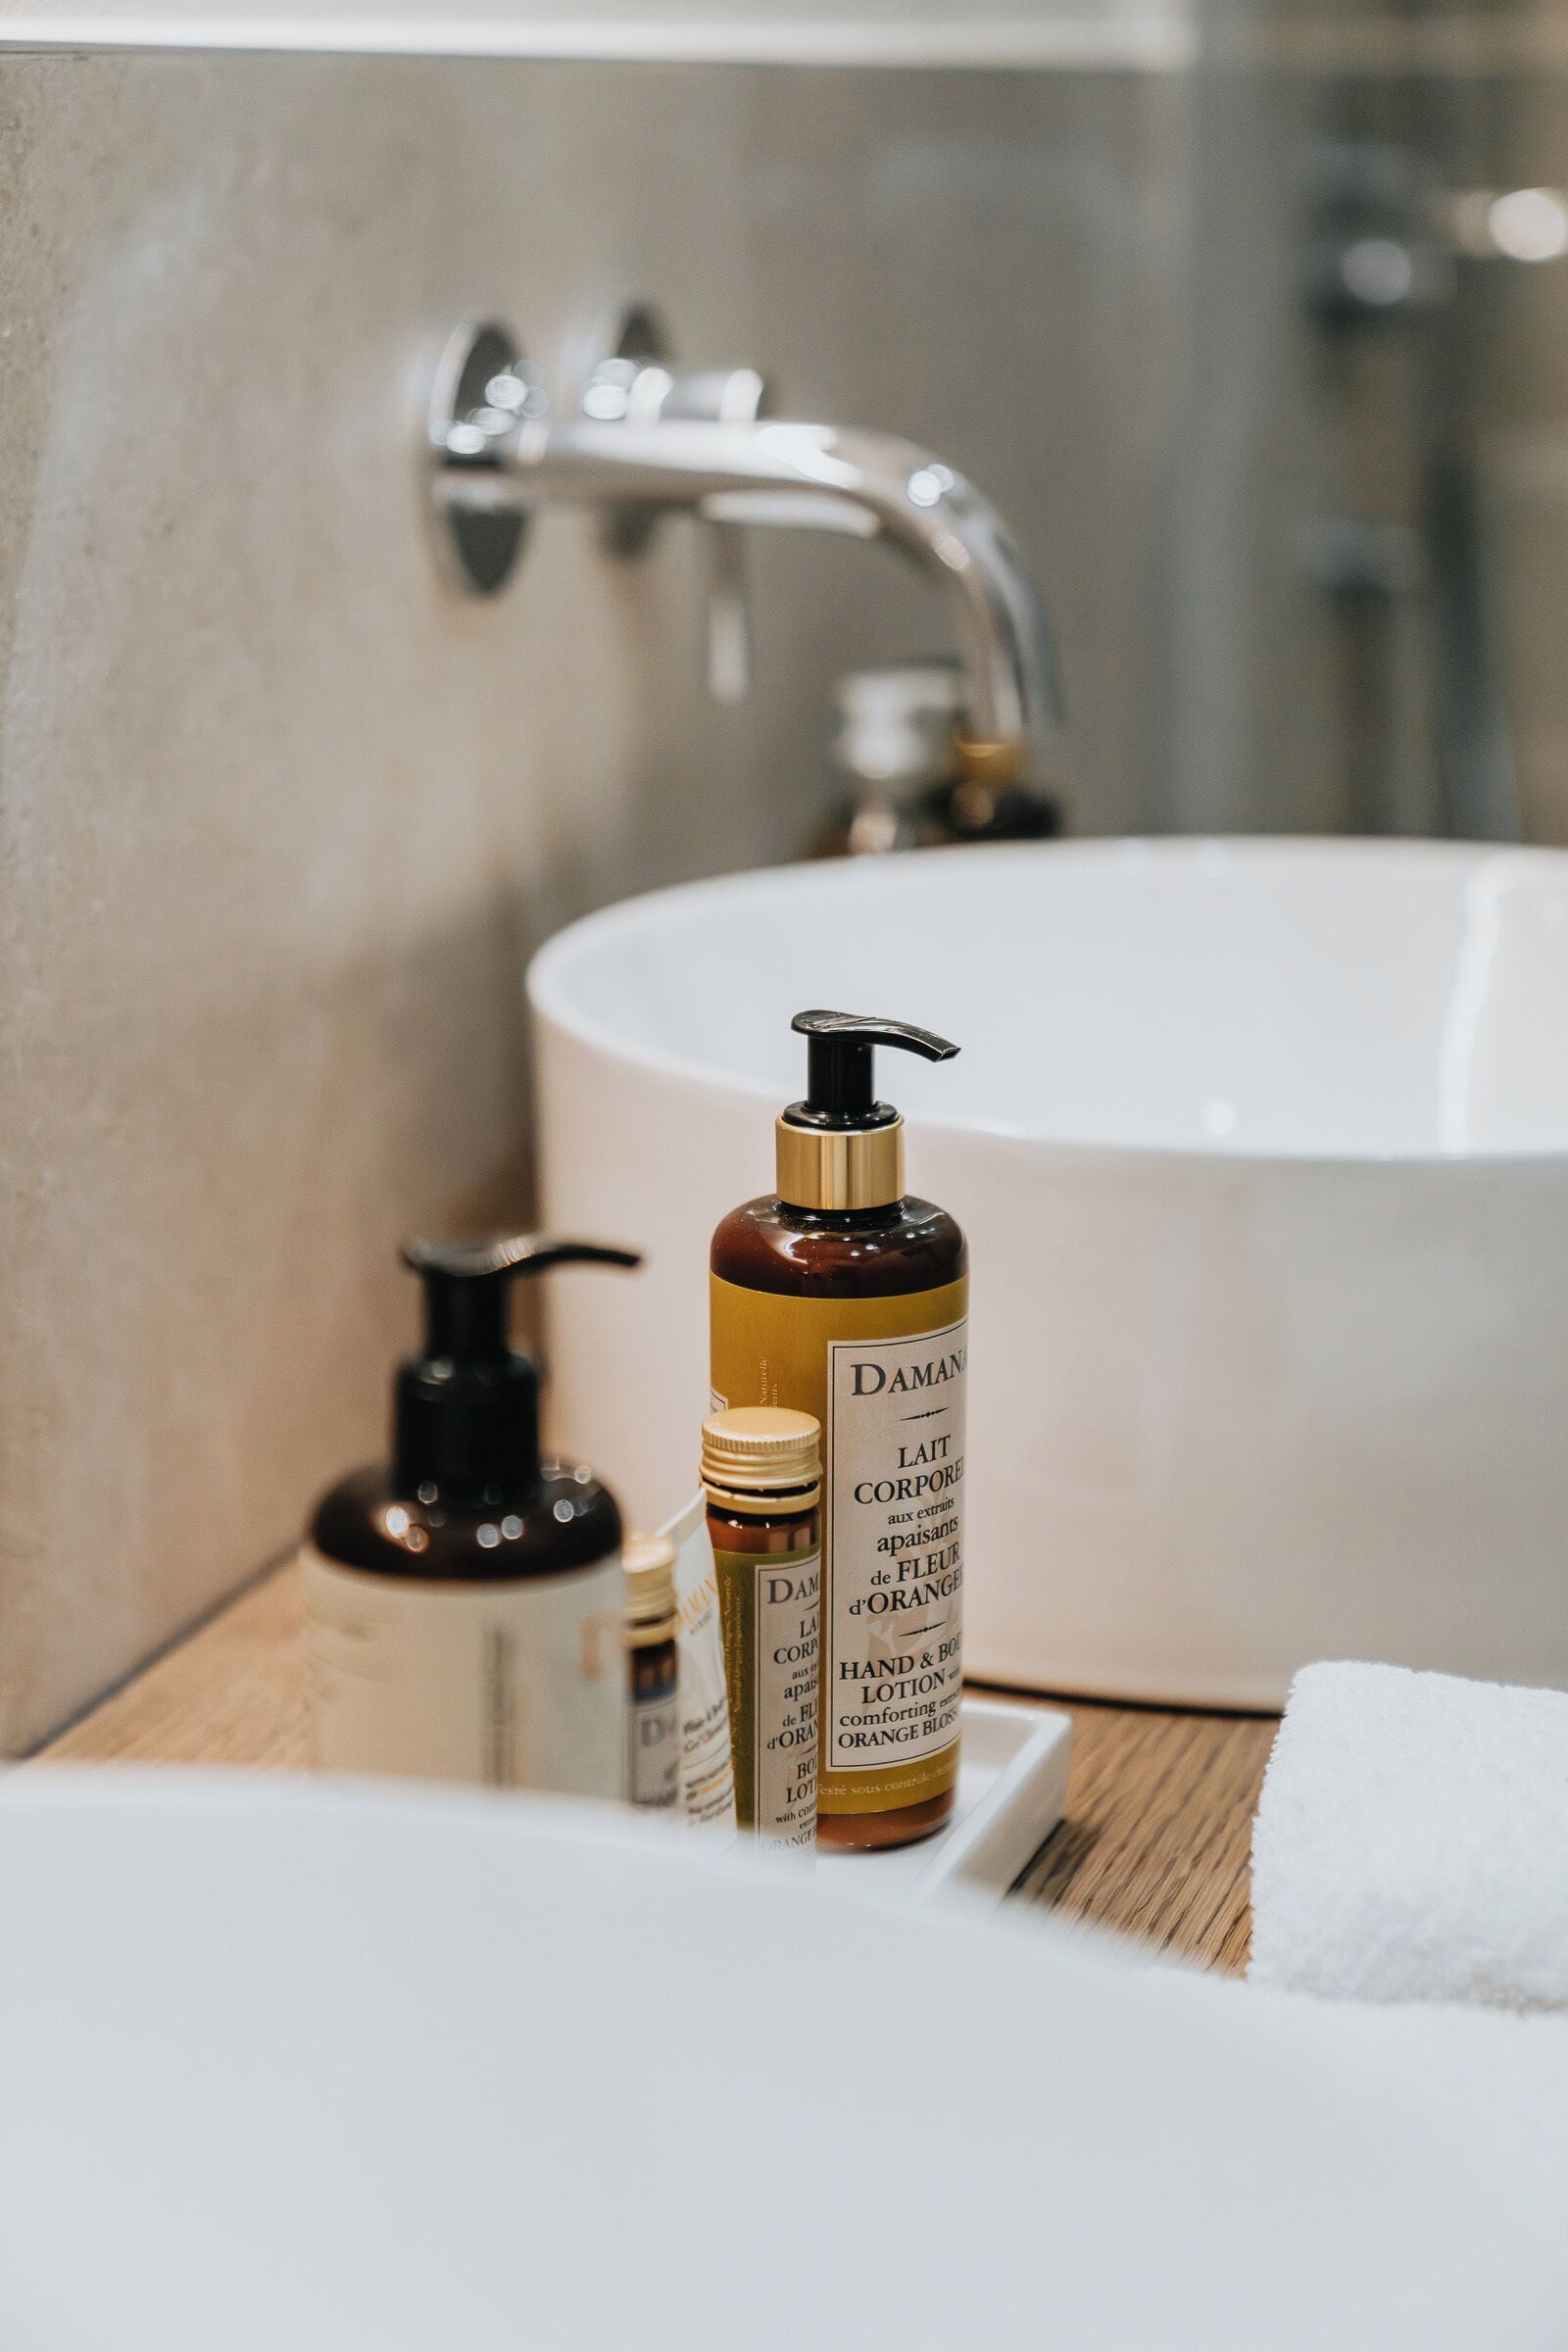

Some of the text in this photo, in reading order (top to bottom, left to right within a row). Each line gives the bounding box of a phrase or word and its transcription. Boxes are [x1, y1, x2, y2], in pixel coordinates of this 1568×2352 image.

[897, 1434, 951, 1469] LAIT
[888, 1496, 955, 1525] aux extraits
[877, 1516, 958, 1556] apaisants
[870, 1542, 960, 1586] de FLEUR
[792, 1666, 808, 1680] aux
[839, 1656, 914, 1681] HAND
[920, 1652, 934, 1670] &
[861, 1668, 945, 1704] LOTION
[782, 1714, 797, 1727] de
[839, 1700, 937, 1728] comforting
[838, 1725, 918, 1749] ORANGE
[851, 1785, 880, 1795] sous
[775, 1811, 796, 1824] with
